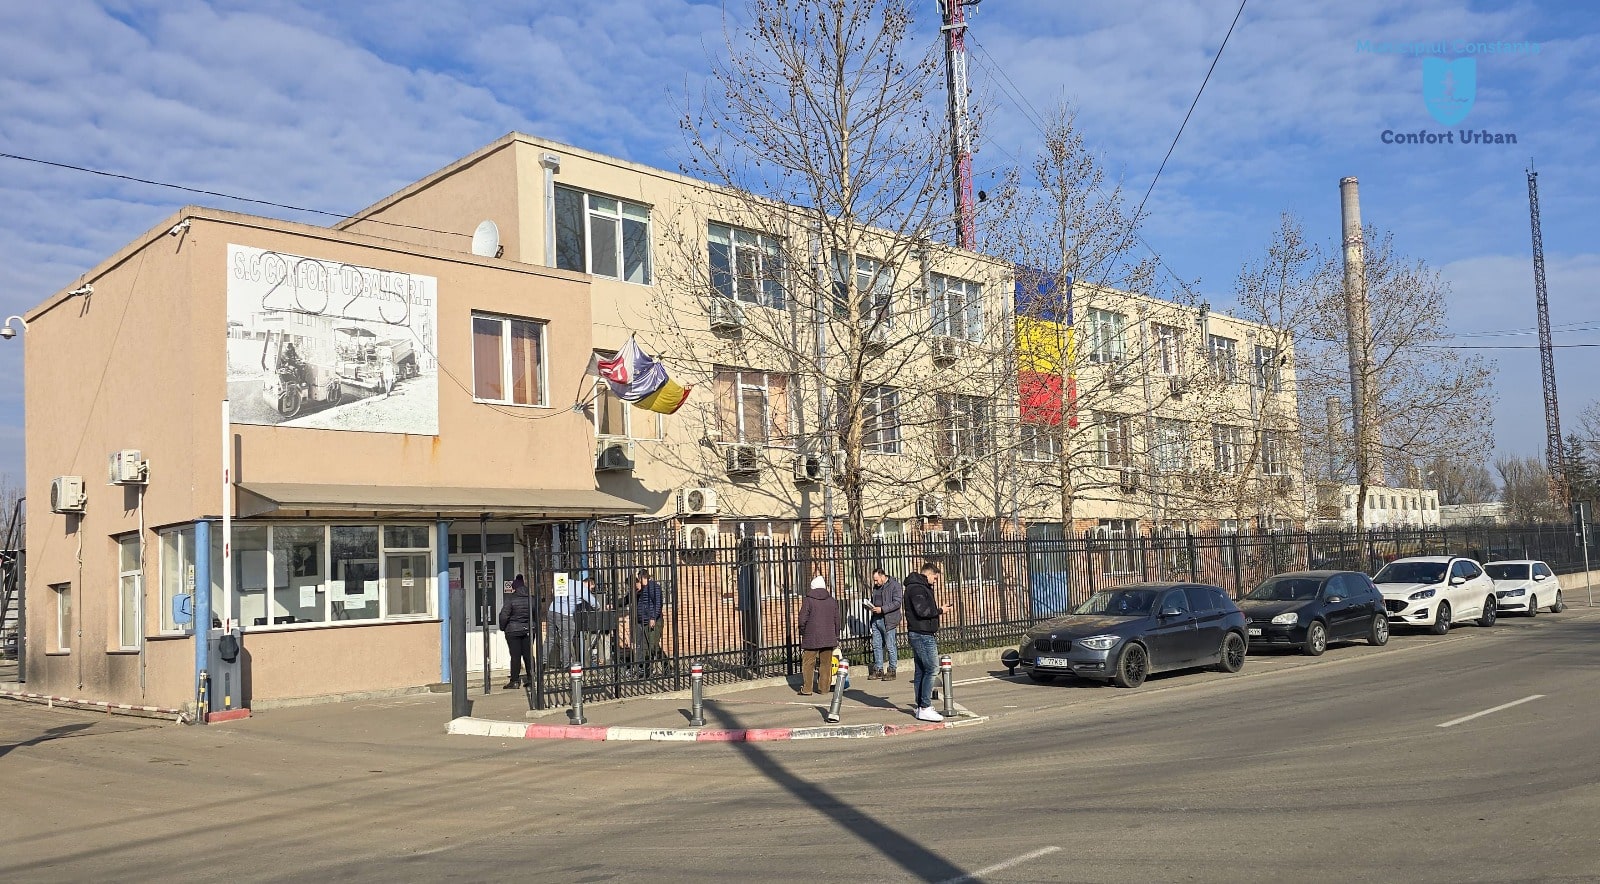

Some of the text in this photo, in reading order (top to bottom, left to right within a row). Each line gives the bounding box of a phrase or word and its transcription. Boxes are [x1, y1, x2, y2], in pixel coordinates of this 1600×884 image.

[259, 250, 408, 325] 2025
[265, 256, 339, 293] CONFORT
[341, 268, 391, 301] URBAN
